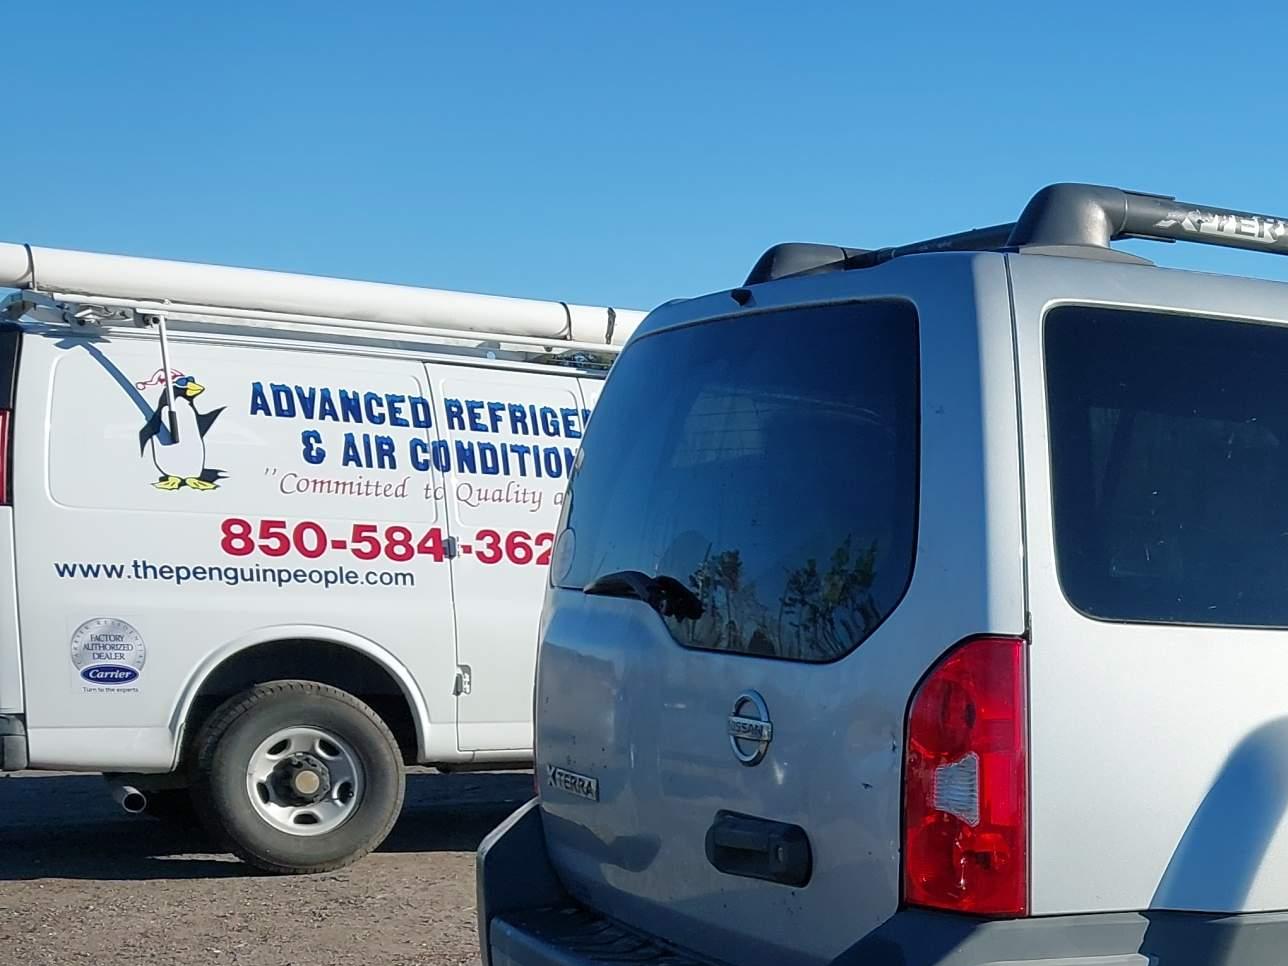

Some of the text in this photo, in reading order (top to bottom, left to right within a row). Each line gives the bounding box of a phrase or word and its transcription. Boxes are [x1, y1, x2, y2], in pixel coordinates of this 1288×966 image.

[250, 381, 432, 429] ADVANCED
[301, 429, 326, 464] &
[342, 432, 397, 470] AIR
[424, 483, 445, 501] to
[456, 481, 542, 513] Quality
[54, 559, 415, 587] www.thepenguinpeople.com
[83, 643, 134, 652] AUTHORIZED
[90, 633, 125, 643] FACTORY
[92, 652, 126, 661] DEALER
[88, 669, 132, 679] Carrier
[546, 764, 595, 800] XTERRA
